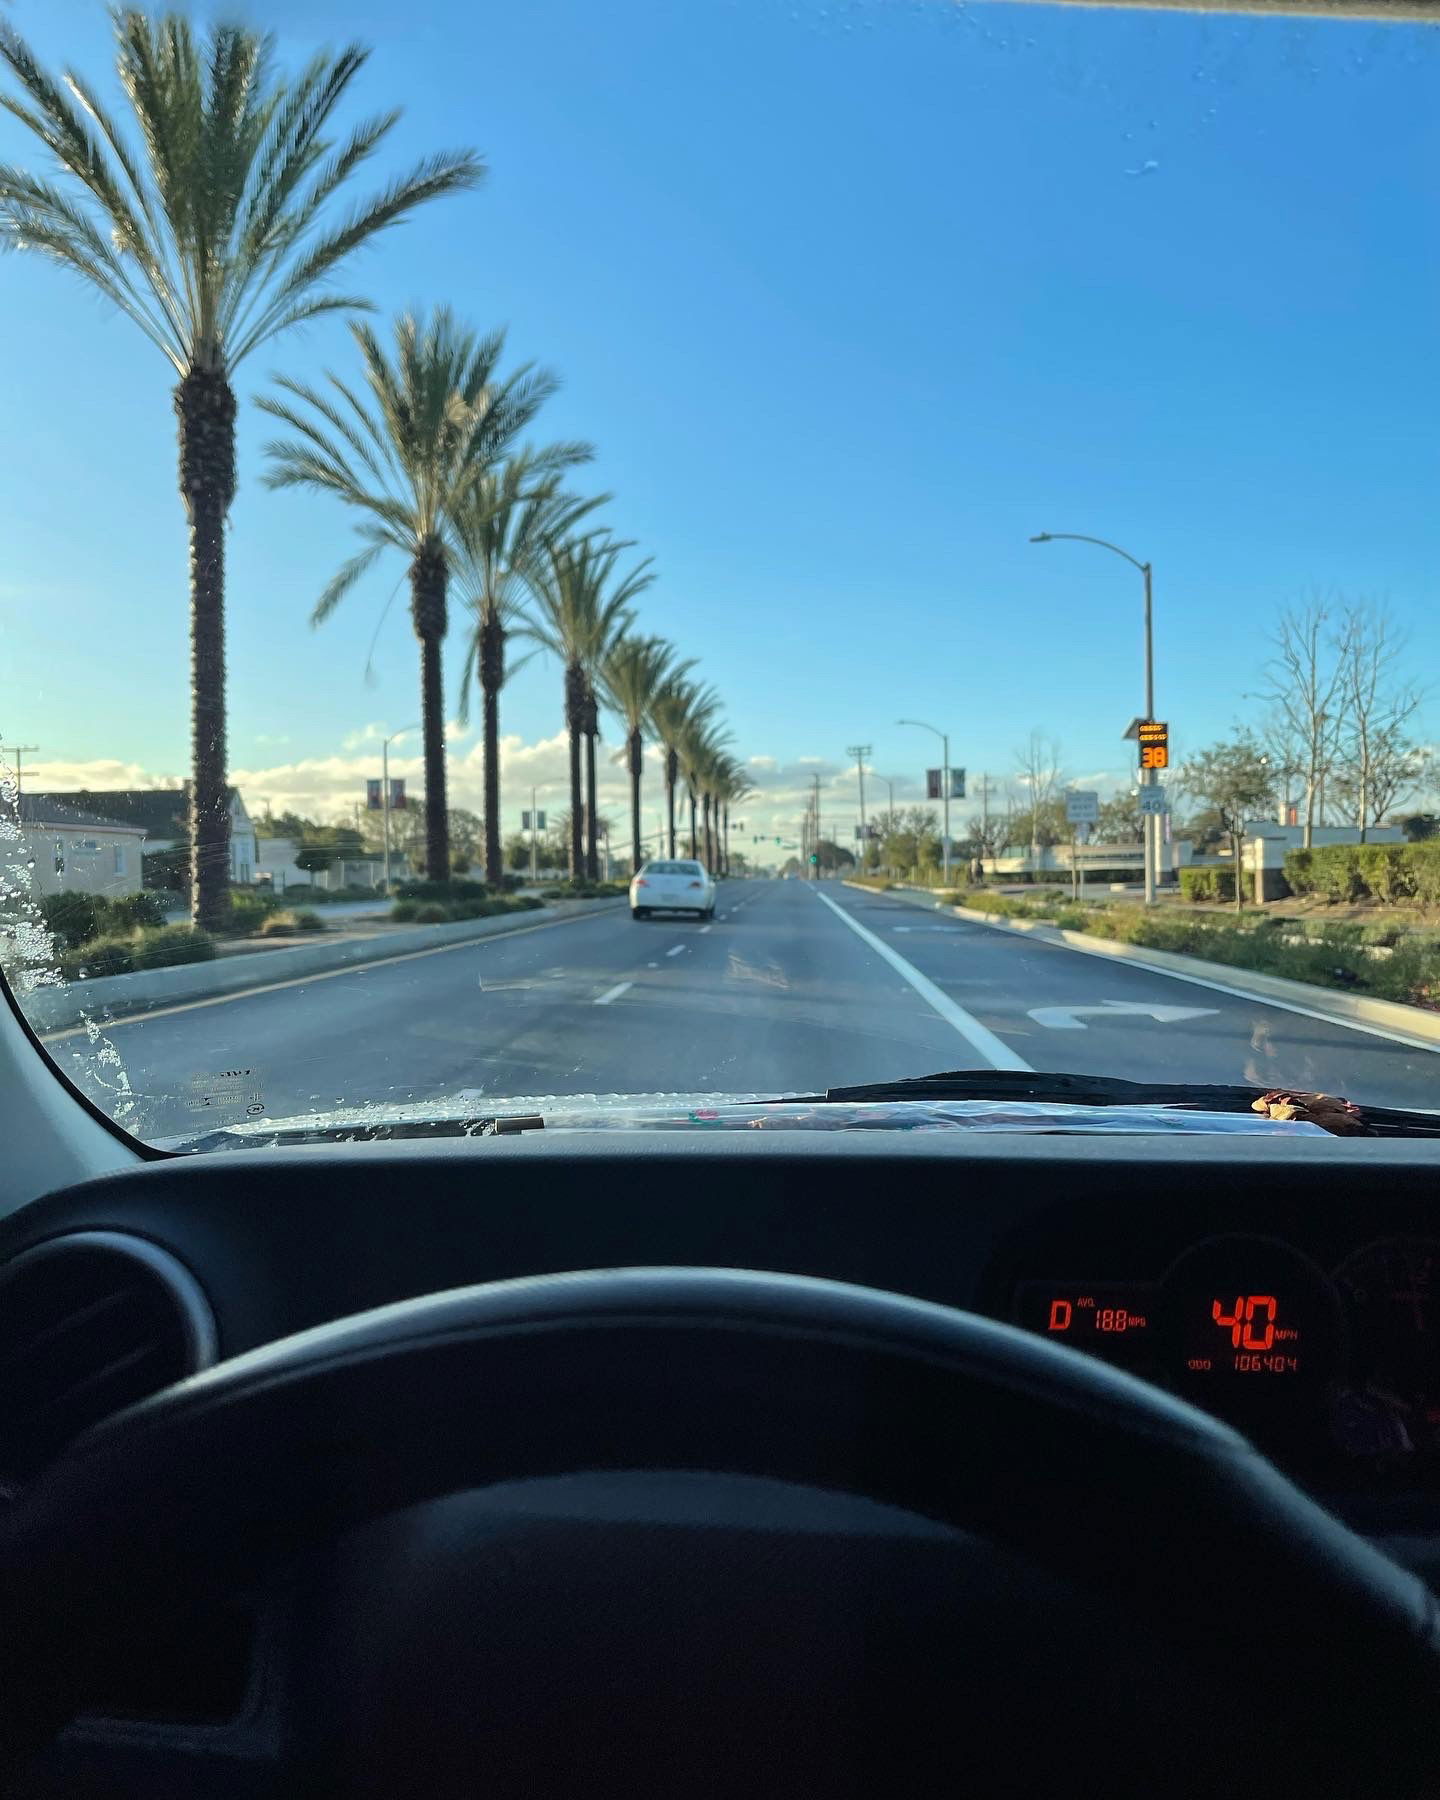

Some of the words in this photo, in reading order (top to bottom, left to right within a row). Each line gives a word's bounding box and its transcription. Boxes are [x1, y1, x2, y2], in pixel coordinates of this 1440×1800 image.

[1143, 747, 1166, 768] 38
[1049, 1301, 1071, 1330] D
[1096, 1310, 1127, 1331] 18.8
[1213, 1296, 1276, 1349] 40
[1275, 1329, 1298, 1340] MPH
[1235, 1355, 1297, 1371] 106404
